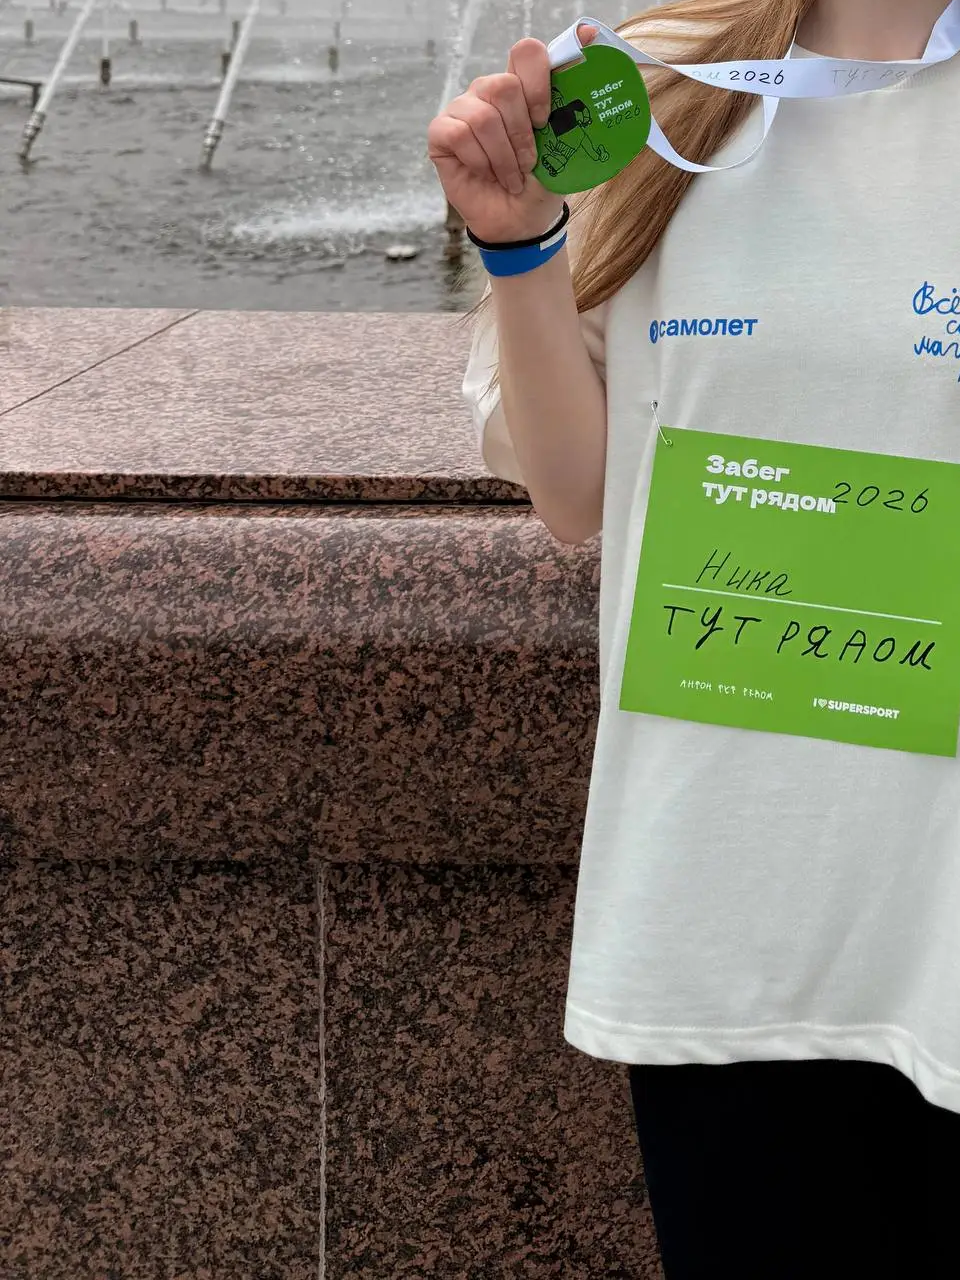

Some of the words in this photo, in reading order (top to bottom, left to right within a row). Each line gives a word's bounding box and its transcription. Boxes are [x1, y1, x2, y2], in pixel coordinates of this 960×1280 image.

[728, 69, 785, 86] 2026
[590, 79, 625, 100] Забег
[594, 95, 614, 111] тут
[598, 98, 634, 122] рядом
[605, 106, 642, 129] 2026
[659, 318, 759, 338] самолет
[705, 454, 790, 482] Забег
[702, 481, 748, 505] тут
[750, 486, 836, 513] рядом
[832, 481, 930, 514] 2026
[695, 548, 793, 596] Ника
[828, 699, 900, 720] SUPERSPORT
